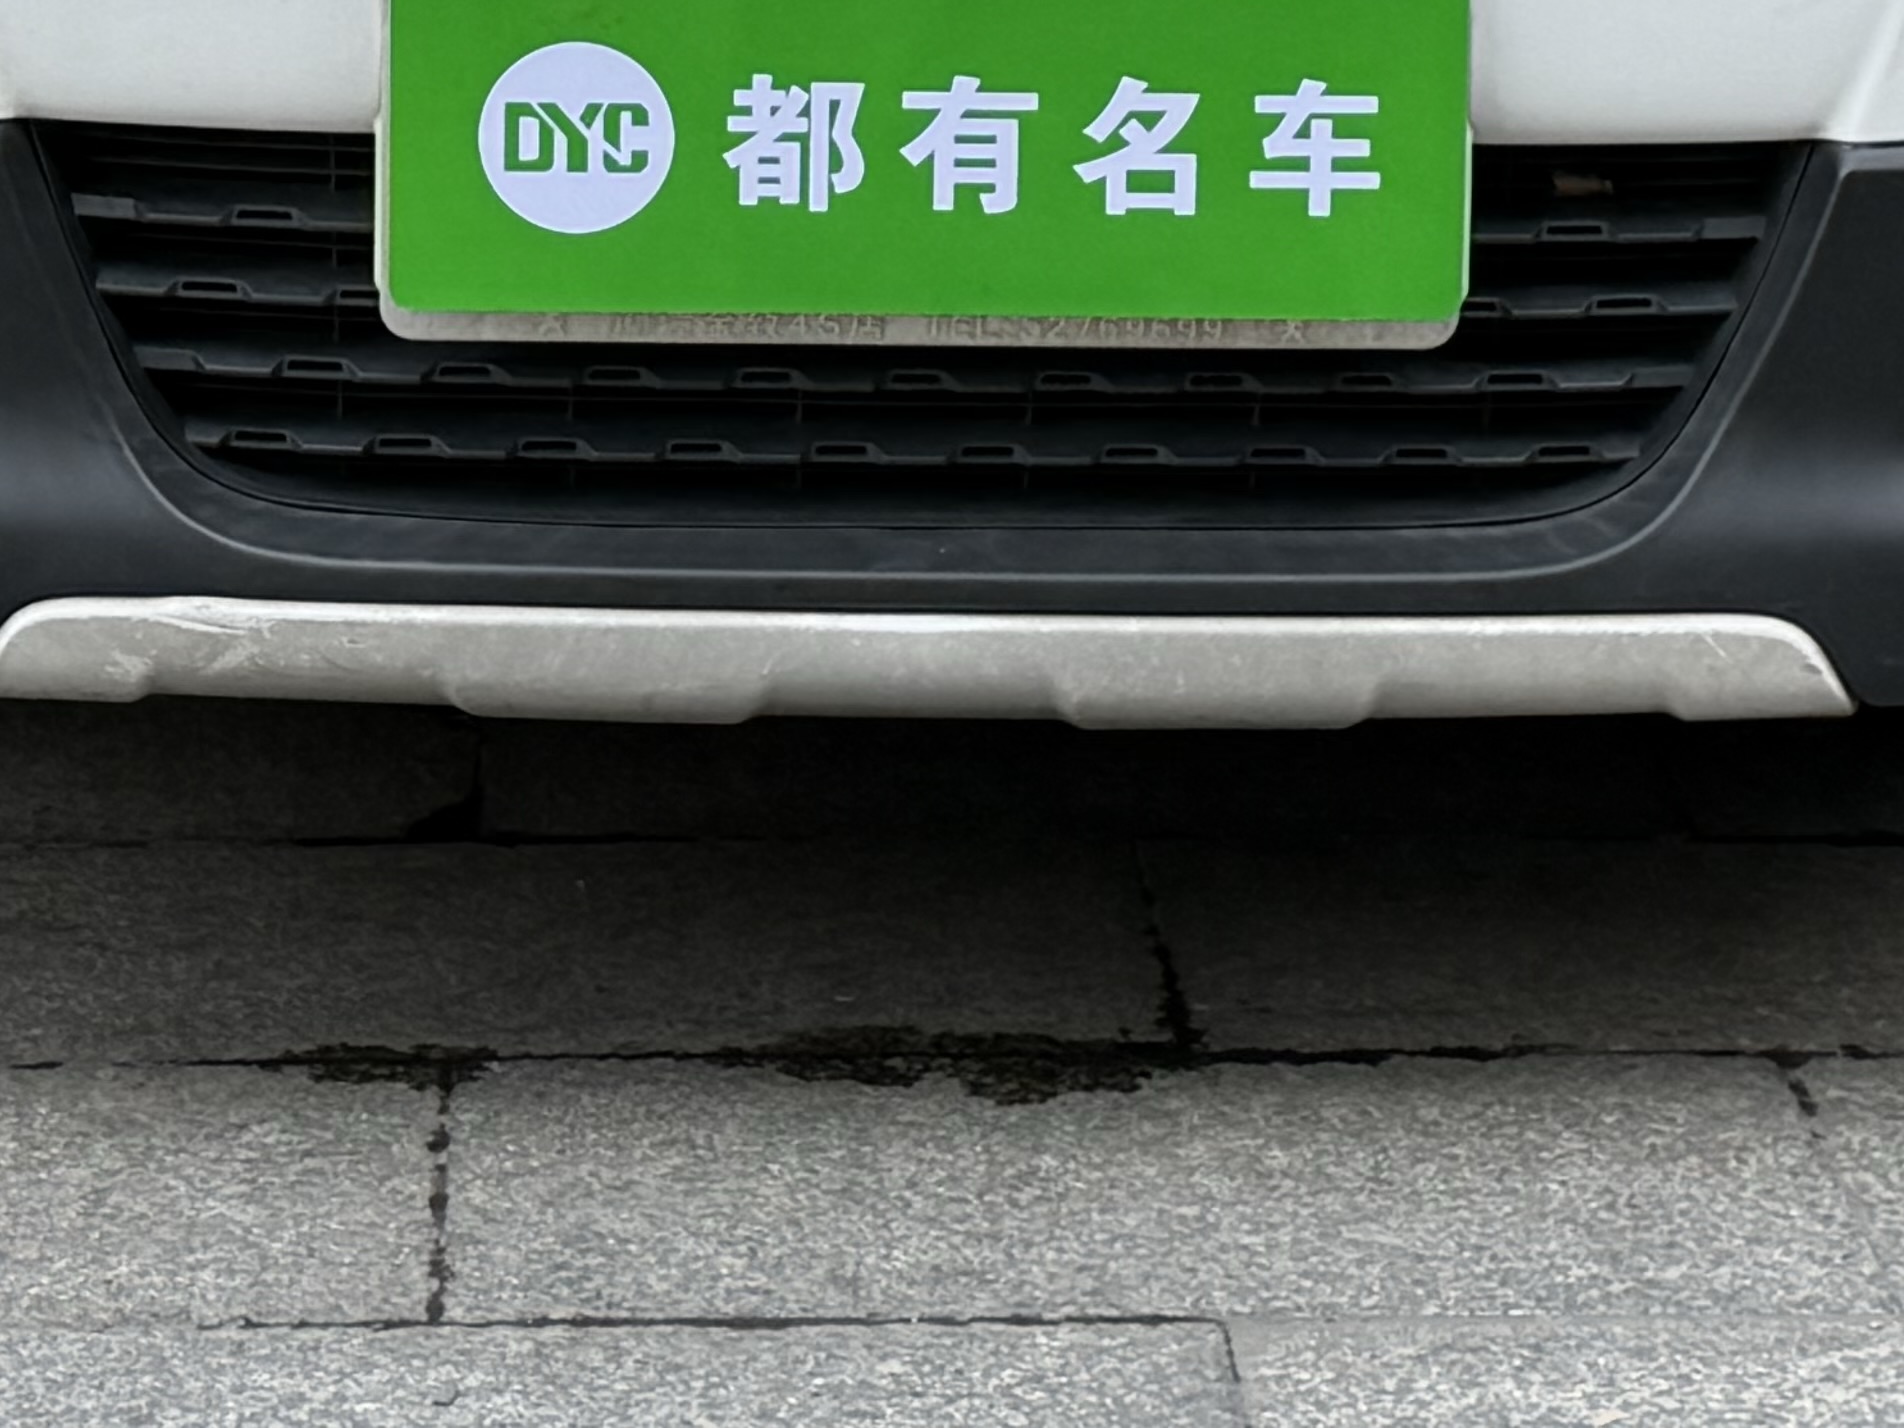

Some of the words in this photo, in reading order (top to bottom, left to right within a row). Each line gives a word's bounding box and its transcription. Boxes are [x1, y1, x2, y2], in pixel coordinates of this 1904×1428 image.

[502, 100, 651, 175] DYC
[722, 74, 1383, 218] 都有名车
